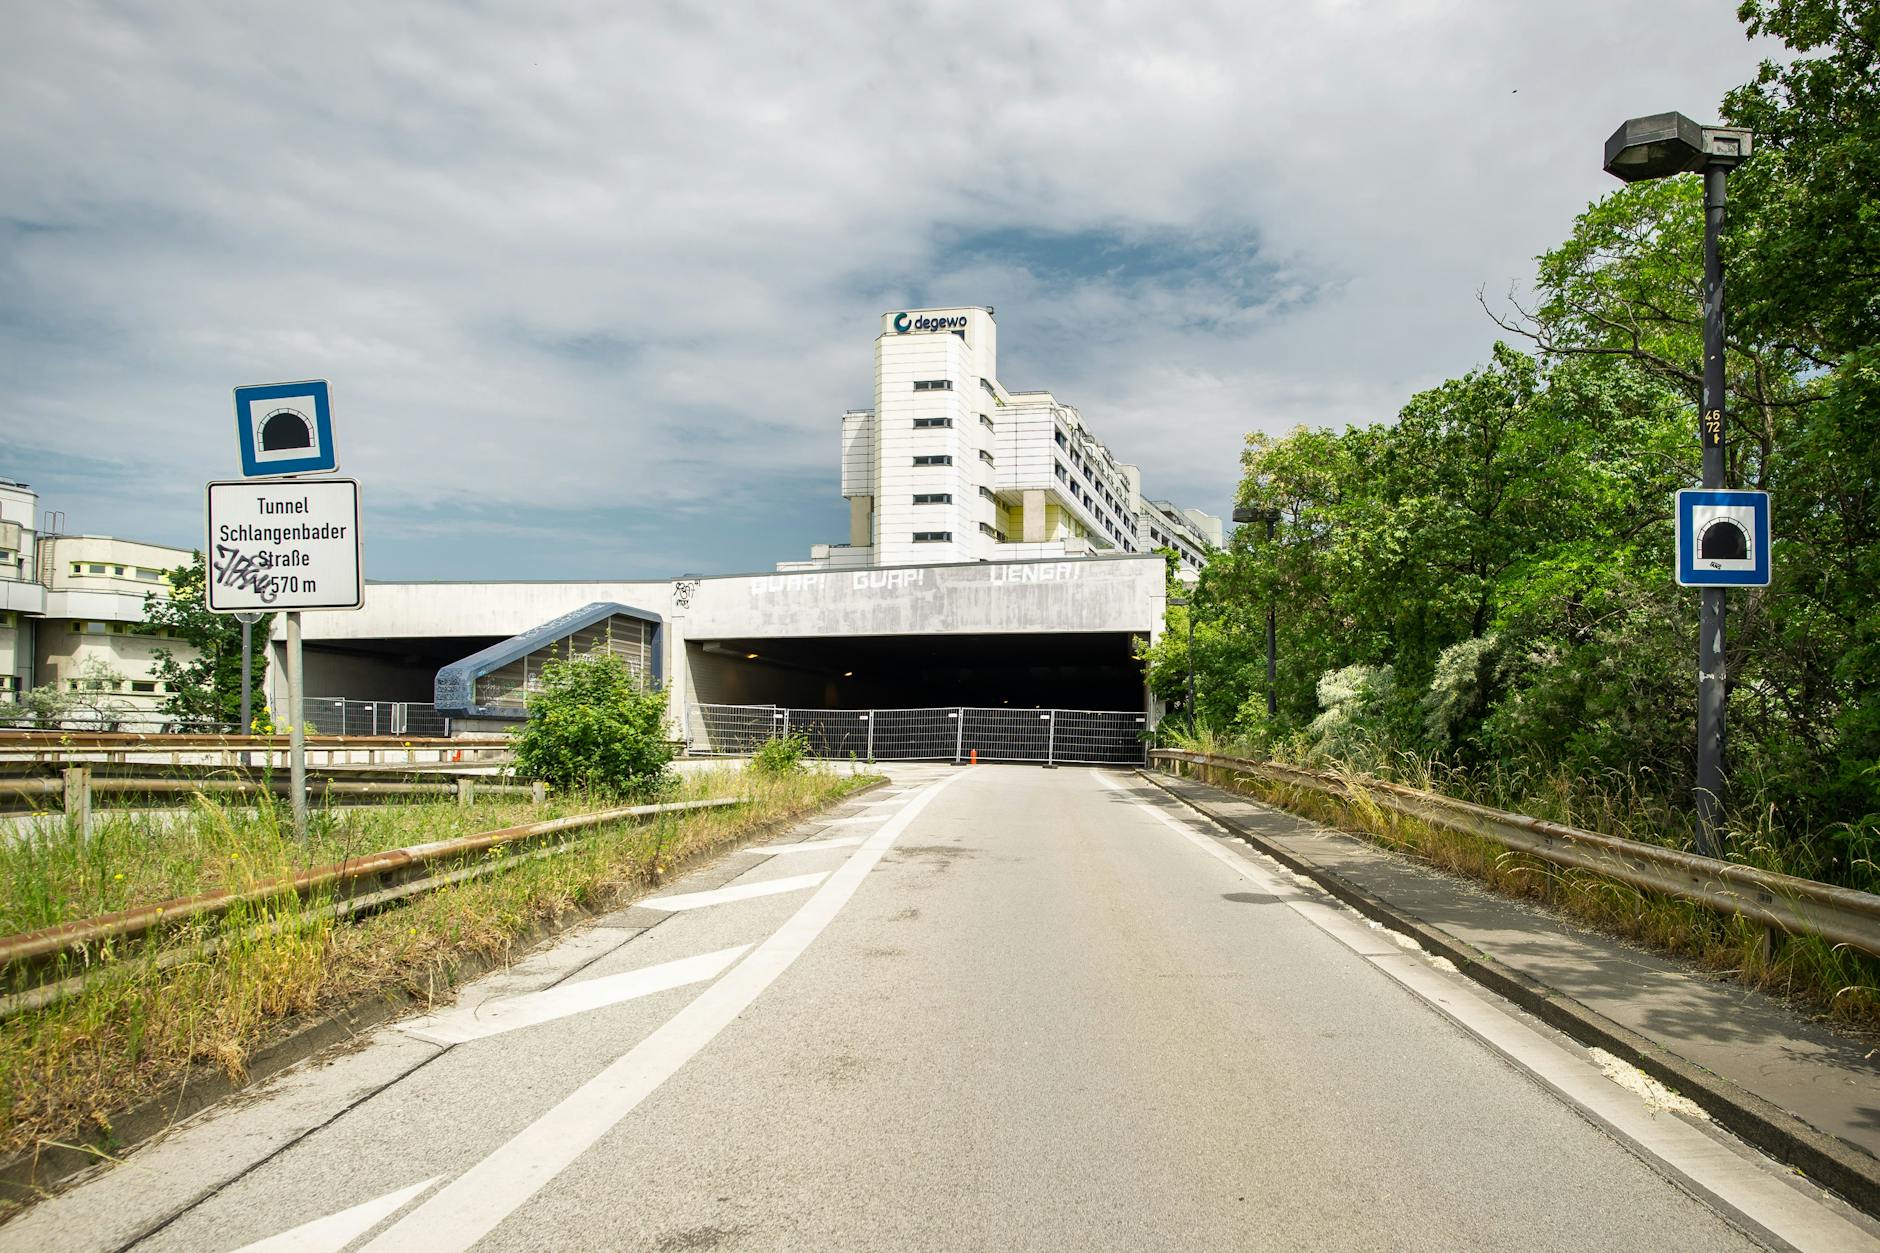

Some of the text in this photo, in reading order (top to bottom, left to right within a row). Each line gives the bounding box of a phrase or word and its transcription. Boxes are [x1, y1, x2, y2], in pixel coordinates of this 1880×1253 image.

[914, 315, 968, 332] degewo
[1704, 409, 1721, 421] 46
[1706, 421, 1720, 433] 72
[257, 497, 309, 515] Tunnel
[220, 523, 347, 545] Schlangenbader
[258, 550, 310, 567] Straße
[271, 576, 298, 593] 570
[303, 580, 316, 593] m
